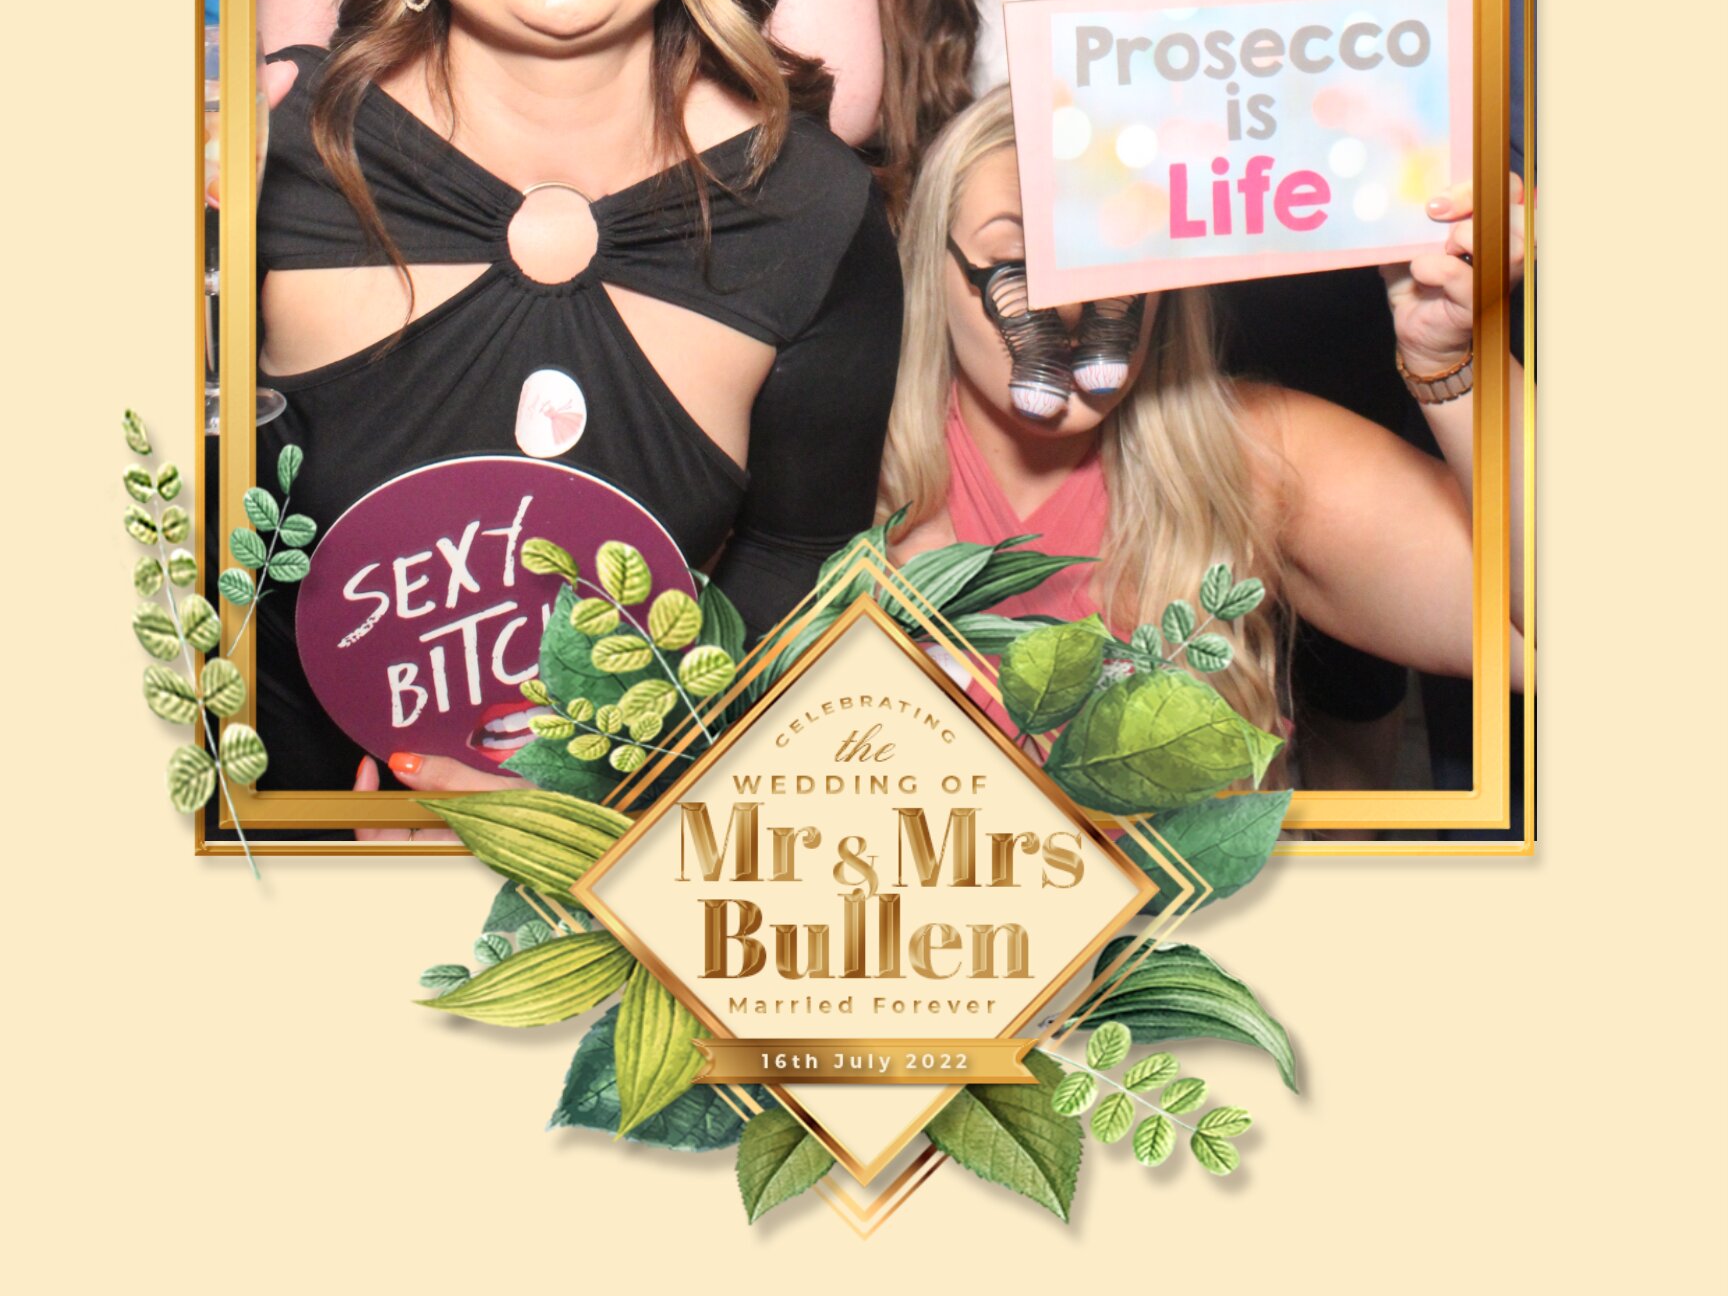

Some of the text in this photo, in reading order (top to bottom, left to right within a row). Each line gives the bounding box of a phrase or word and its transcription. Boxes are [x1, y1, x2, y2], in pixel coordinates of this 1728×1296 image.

[1075, 19, 1431, 88] Prosecco
[1226, 82, 1277, 142] is
[1168, 155, 1332, 240] Life
[337, 495, 534, 649] SEXY
[387, 600, 552, 728] BITC
